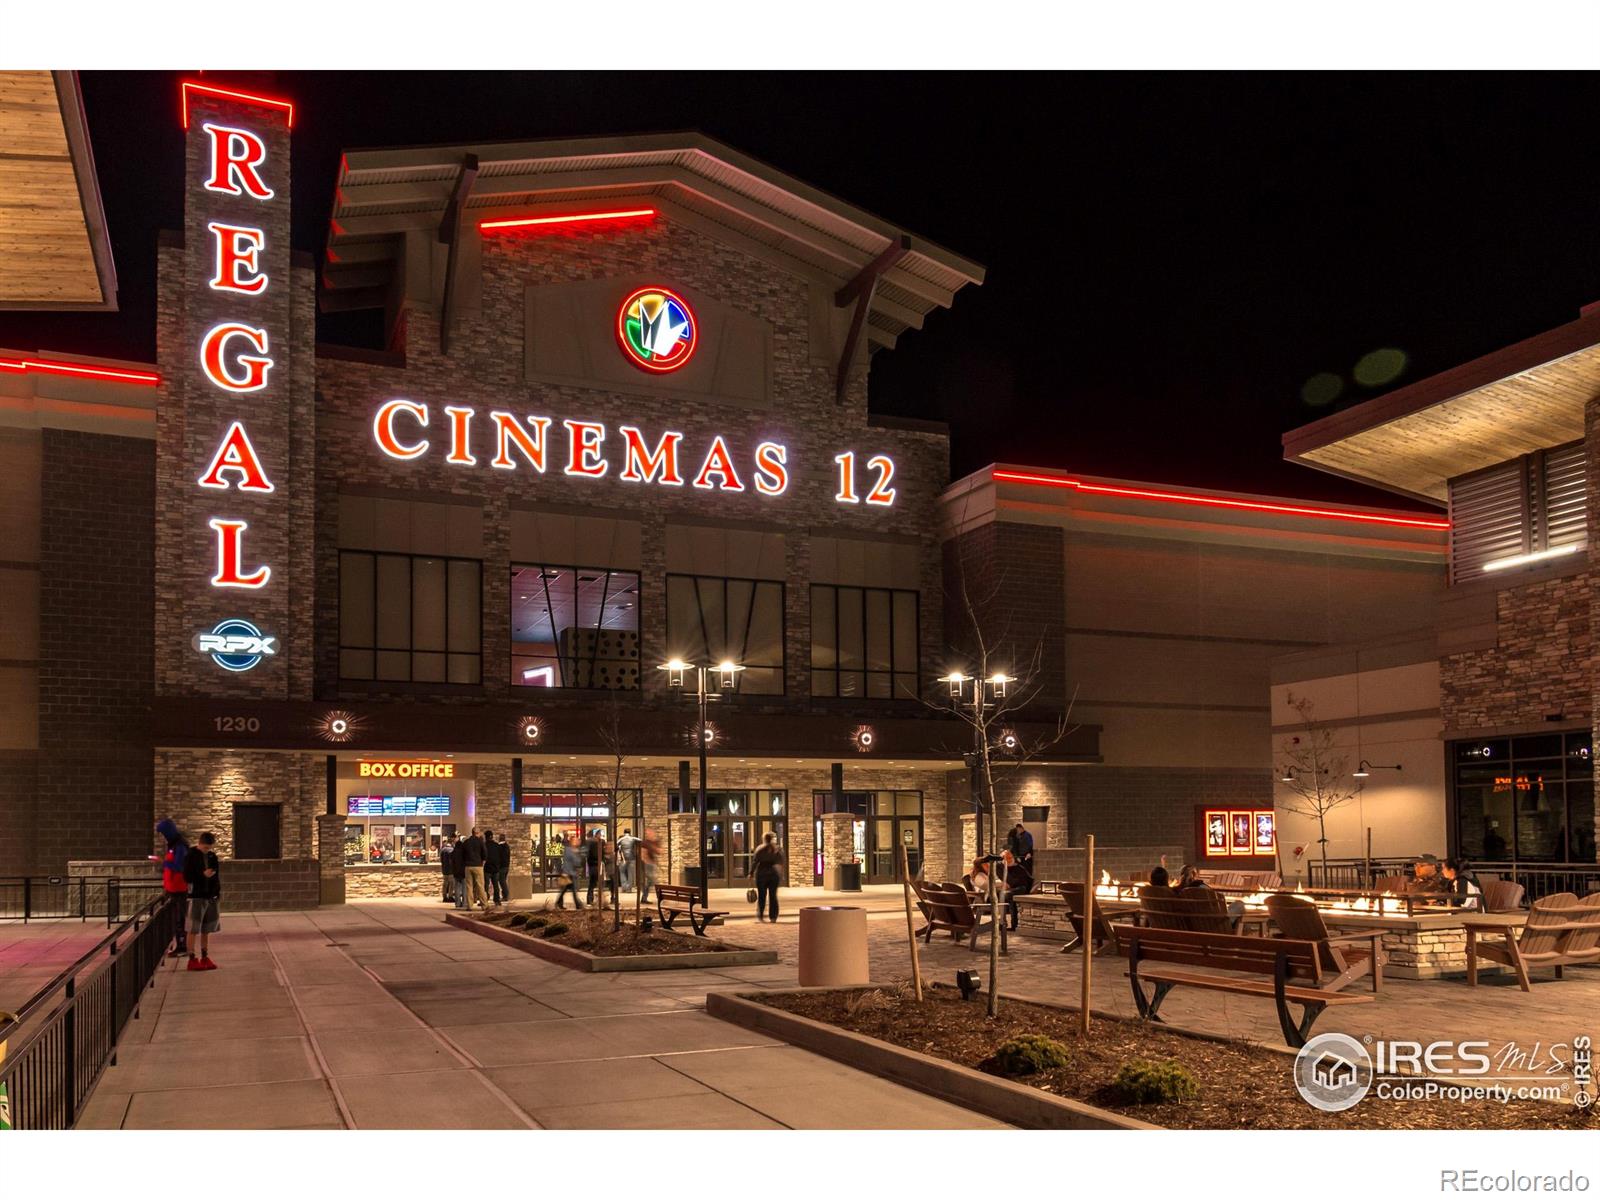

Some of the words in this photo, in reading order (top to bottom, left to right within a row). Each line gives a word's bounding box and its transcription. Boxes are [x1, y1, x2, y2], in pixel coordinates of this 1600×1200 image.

[199, 122, 275, 589] REGAL
[373, 399, 789, 496] CINEMAS
[834, 452, 896, 505] 12
[199, 635, 276, 654] RPX
[214, 716, 260, 732] 1230
[360, 763, 395, 777] BOX
[398, 763, 453, 777] OFFICE
